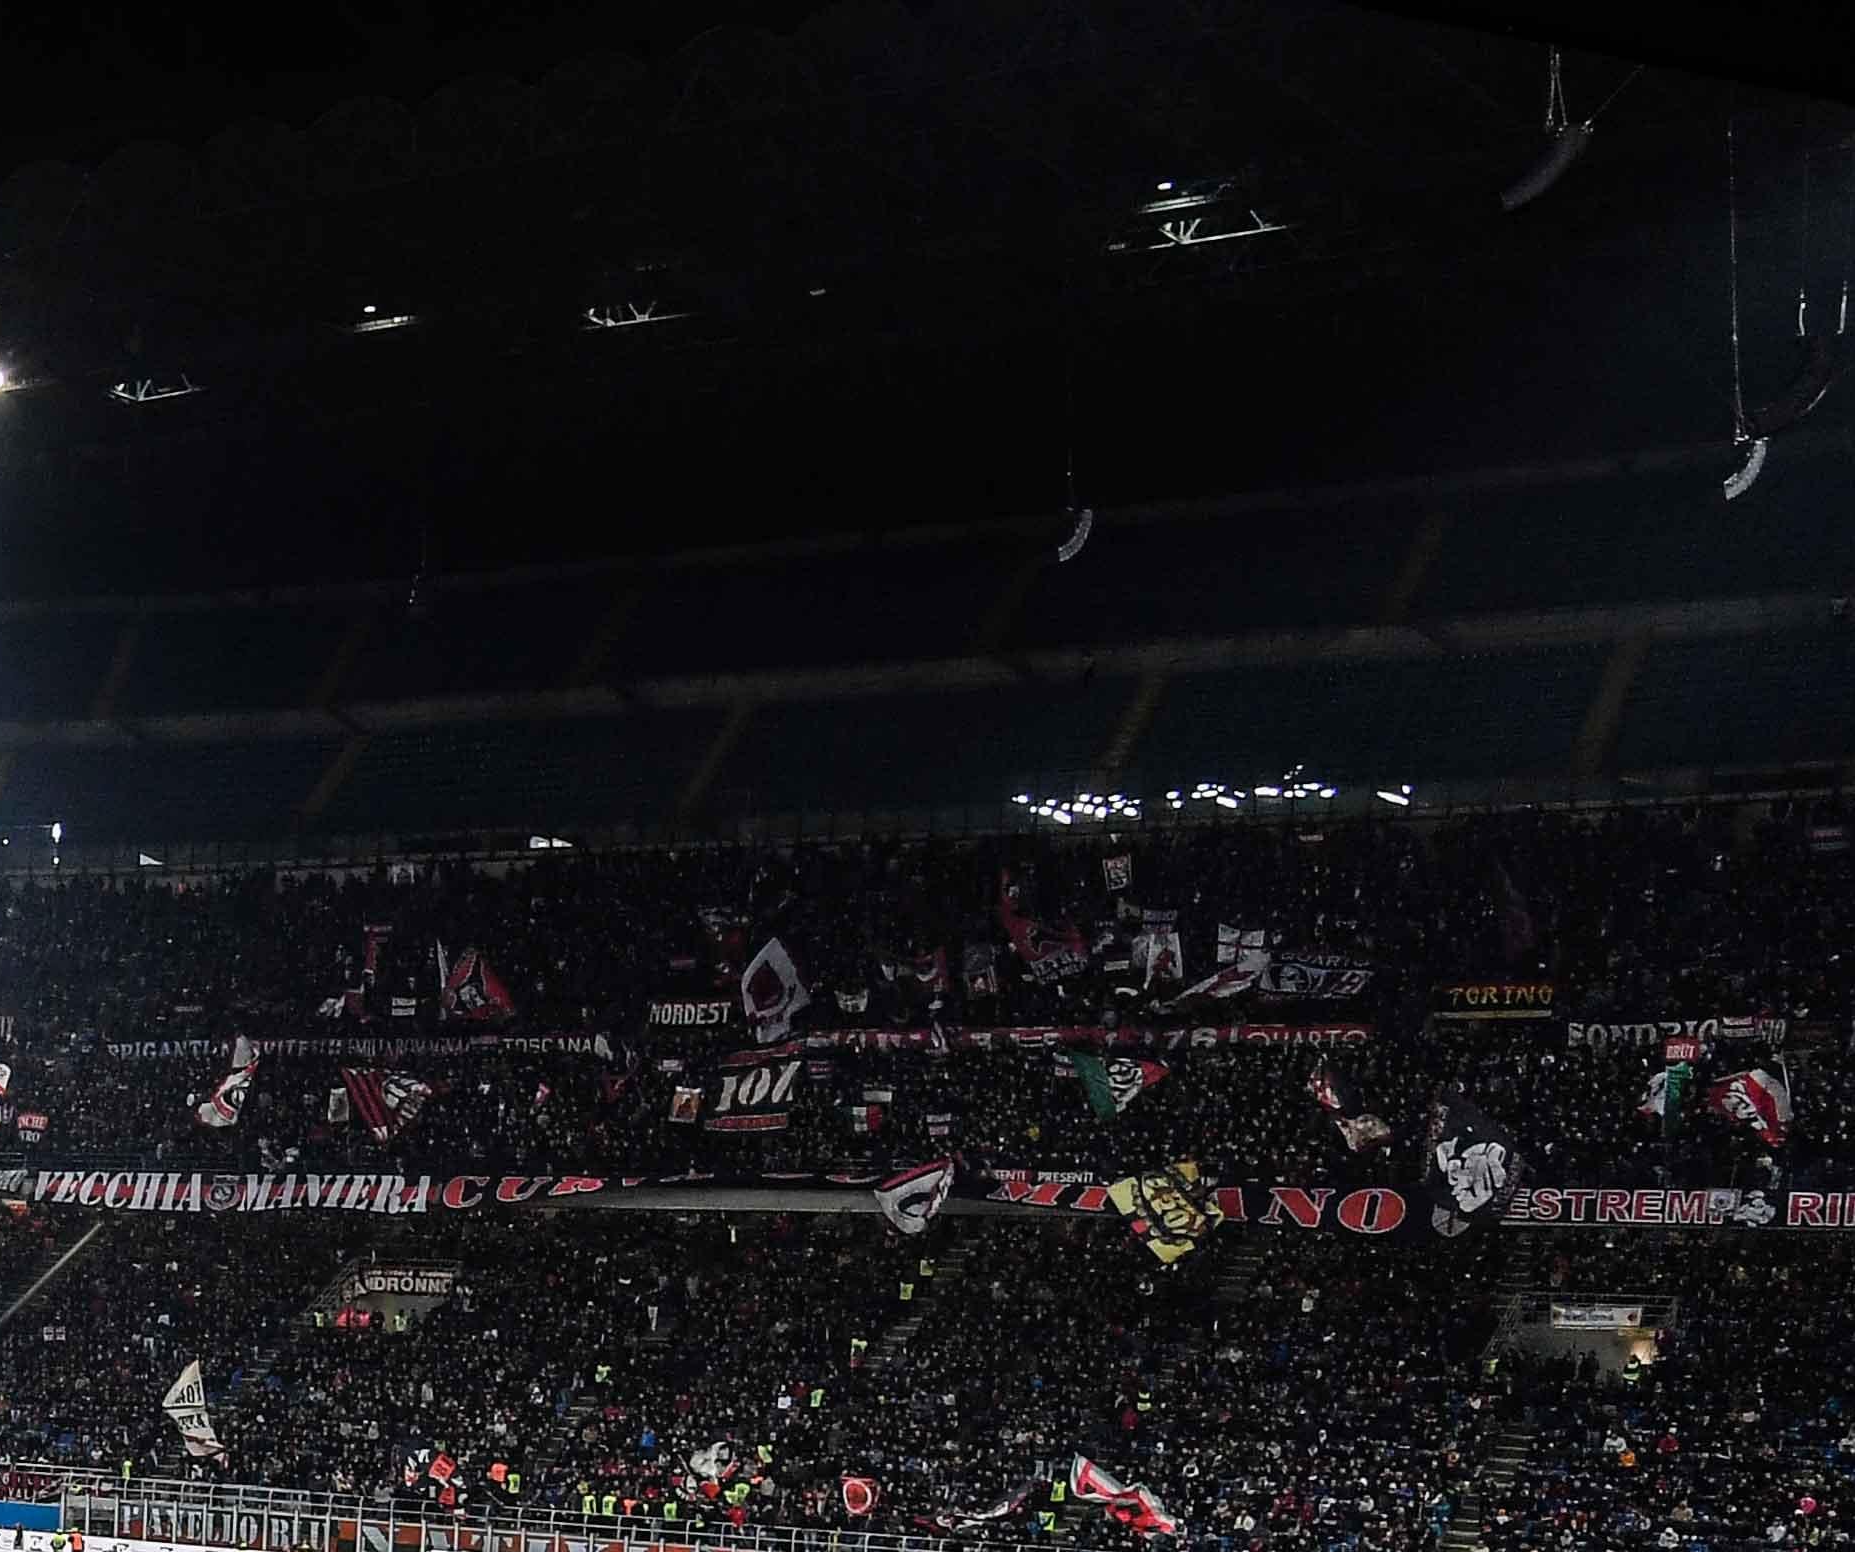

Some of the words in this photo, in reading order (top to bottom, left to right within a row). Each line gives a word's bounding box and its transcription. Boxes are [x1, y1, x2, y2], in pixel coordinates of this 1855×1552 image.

[648, 1000, 731, 1025] NORDEST
[497, 1038, 593, 1056] TOSCANA
[1035, 1169, 1094, 1186] PRESENTI
[35, 1170, 203, 1212] VECCHIA
[237, 1173, 431, 1214] MANIERA
